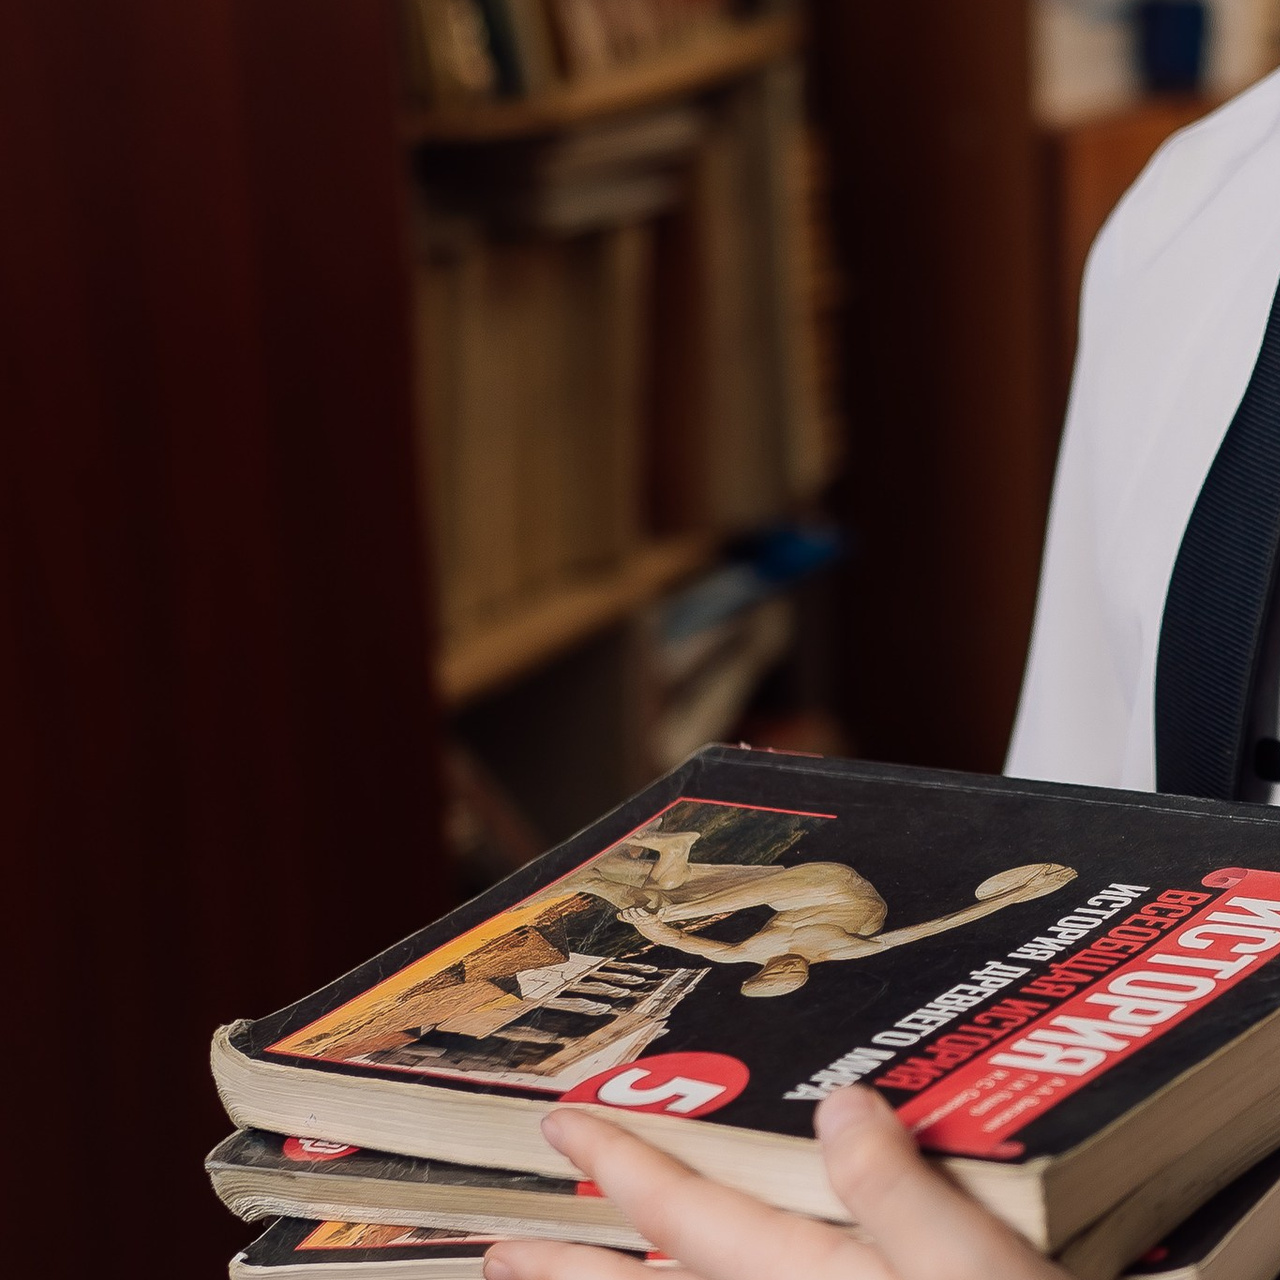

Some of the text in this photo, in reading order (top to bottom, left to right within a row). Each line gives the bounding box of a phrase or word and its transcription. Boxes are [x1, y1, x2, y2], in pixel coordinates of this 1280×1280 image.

[1008, 883, 1150, 961] ИСТОРИЯ
[872, 961, 1031, 1047] ДРЕВНЕГО
[874, 889, 1212, 1091] ВСЕОБЩАЯ ИСТОРИЯ
[597, 1067, 727, 1114] 5
